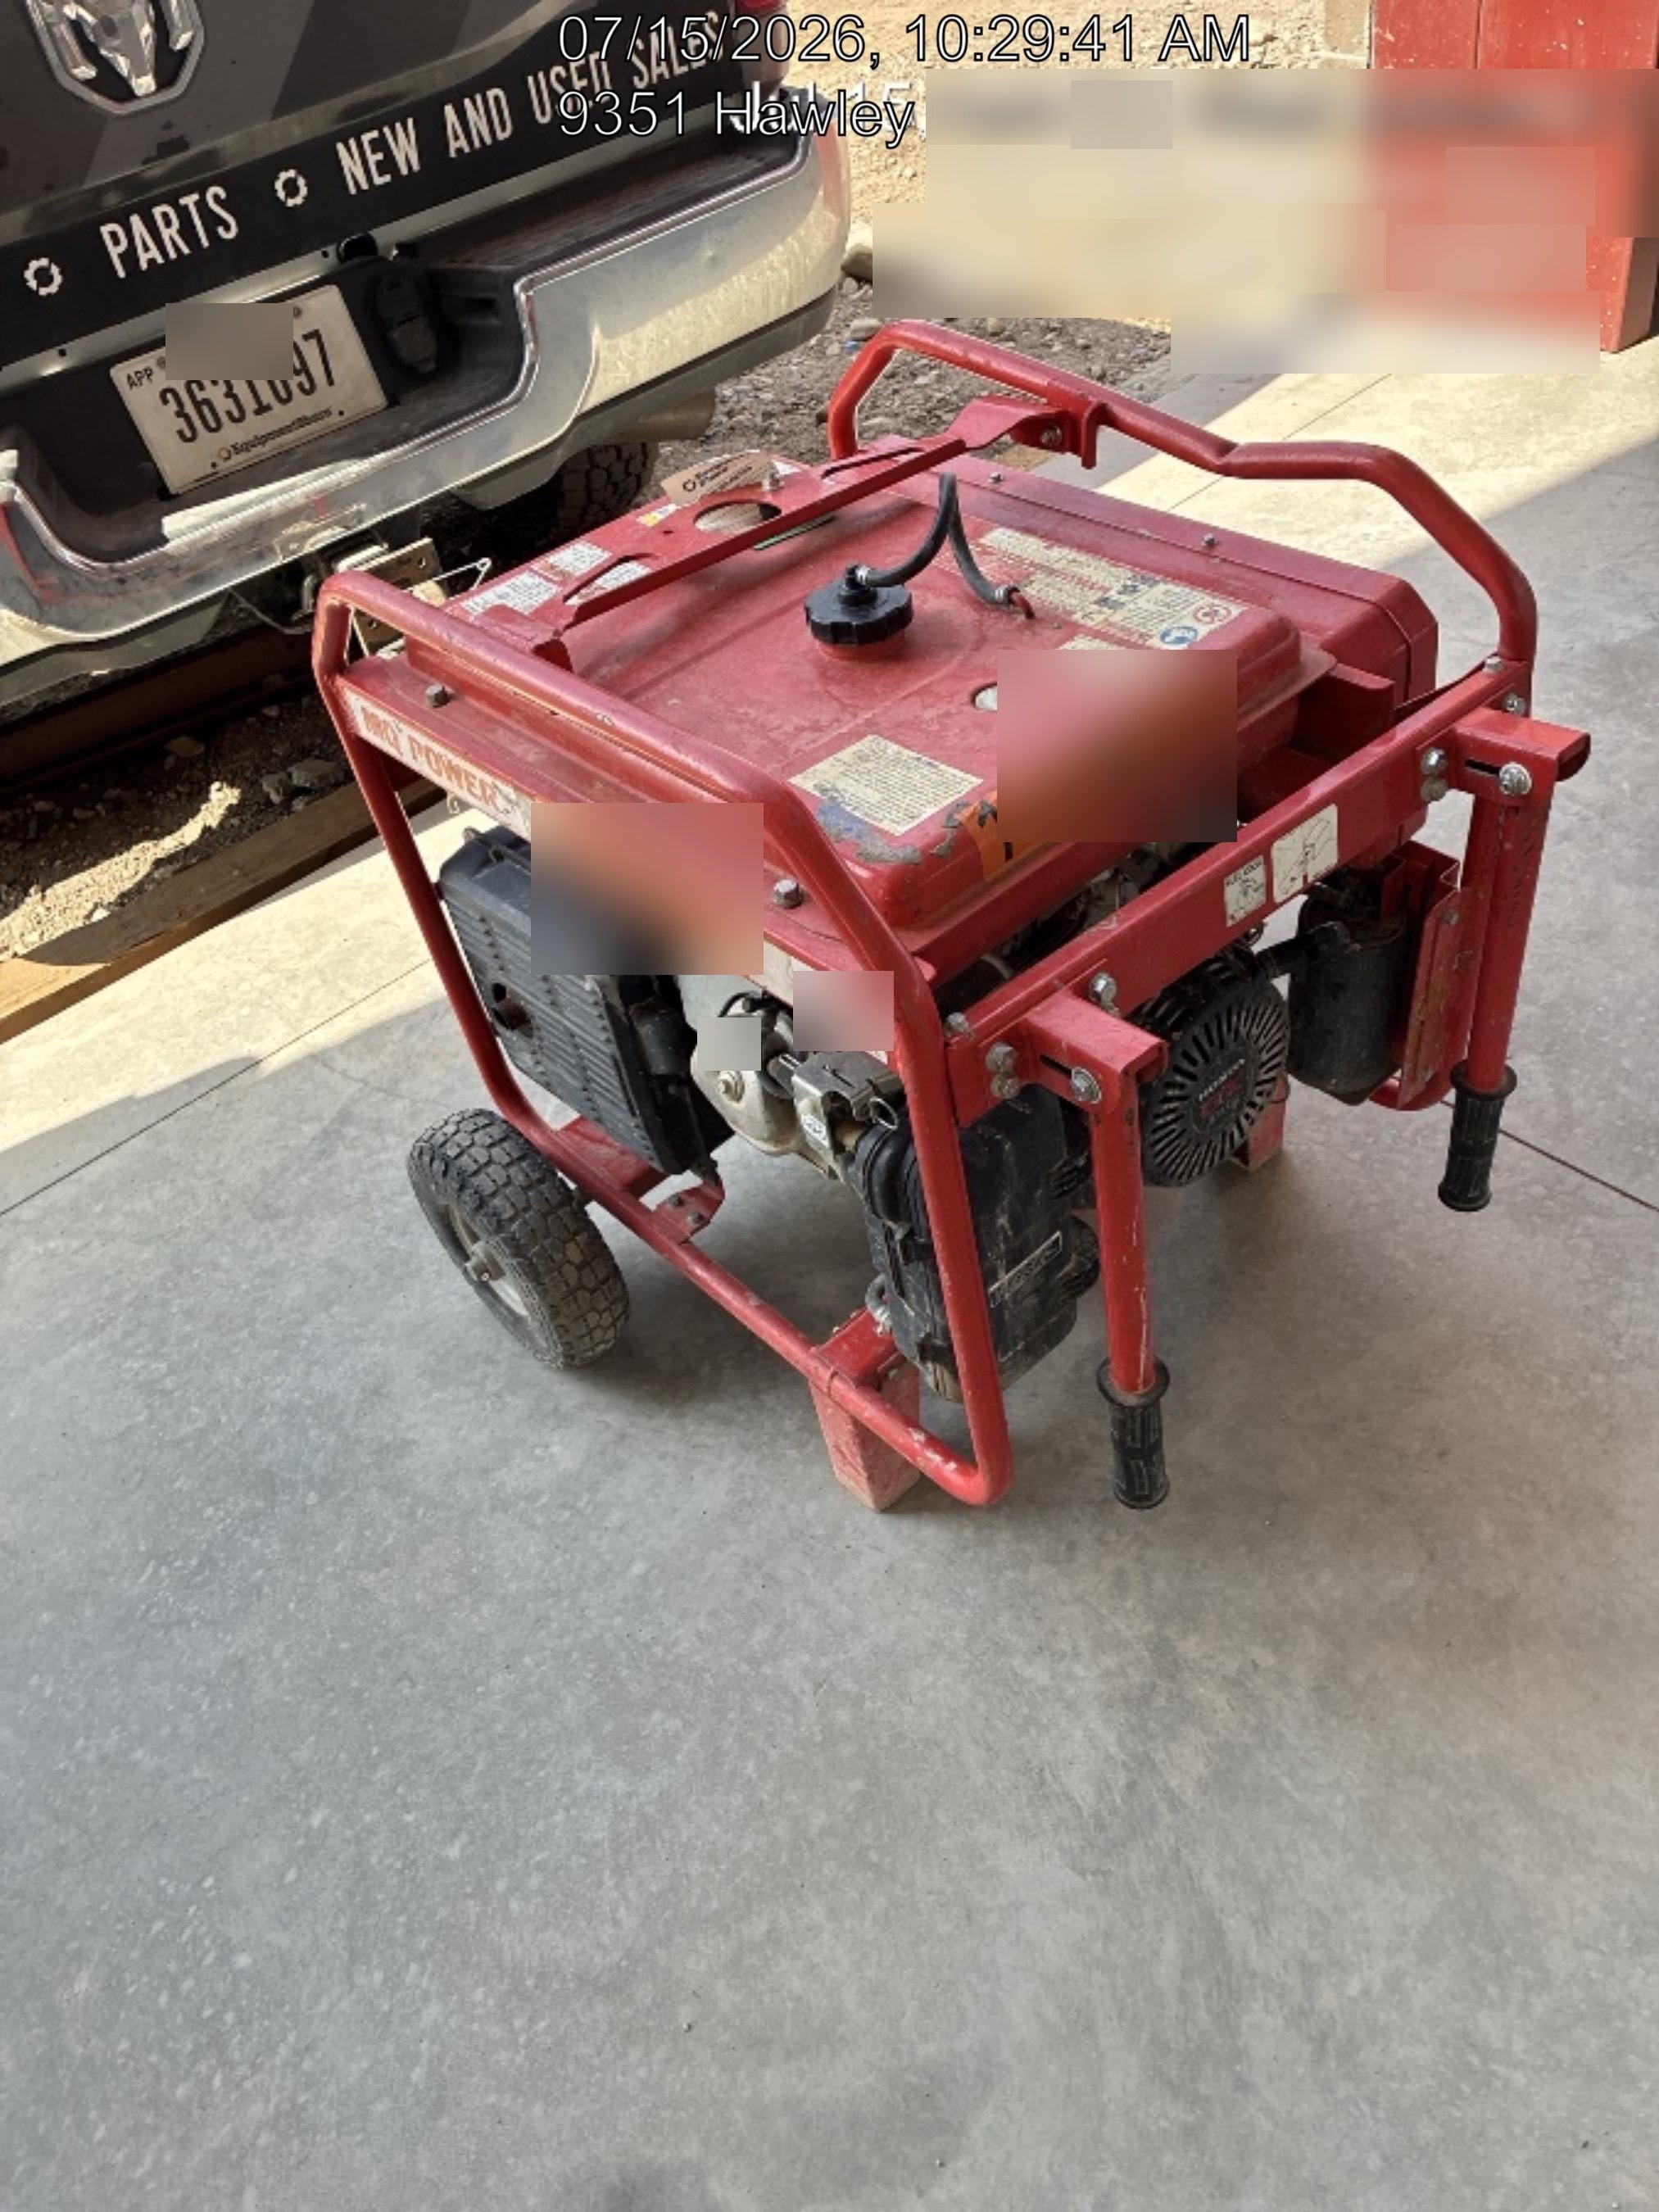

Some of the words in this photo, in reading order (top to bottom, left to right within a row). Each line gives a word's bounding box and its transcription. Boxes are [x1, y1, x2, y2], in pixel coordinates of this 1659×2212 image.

[100, 185, 238, 279] PARTS
[336, 117, 421, 196] NEW
[443, 86, 513, 160] AND
[527, 51, 614, 125] USED
[631, 11, 724, 89] SALES
[125, 367, 154, 391] APP
[410, 736, 500, 806] POWER
